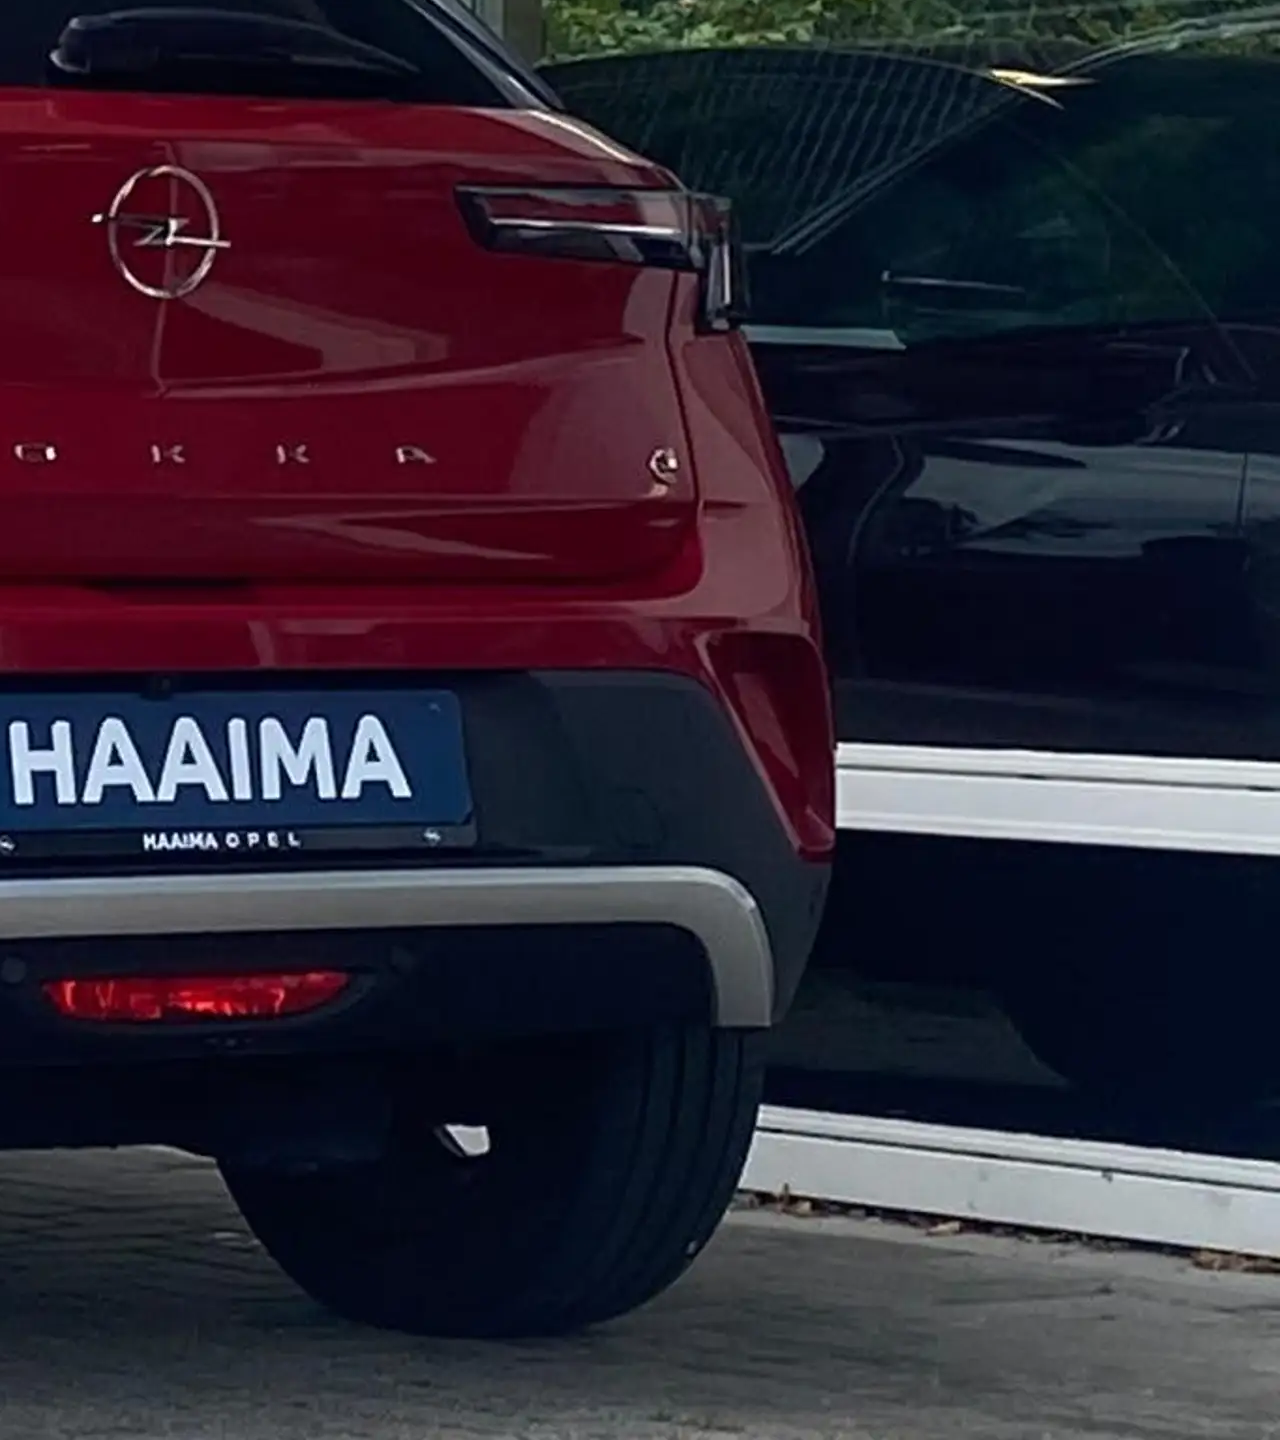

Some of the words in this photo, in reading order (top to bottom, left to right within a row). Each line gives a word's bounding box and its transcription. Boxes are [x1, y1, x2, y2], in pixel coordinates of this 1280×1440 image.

[8, 714, 412, 805] HAAIMA
[143, 831, 219, 851] HAAIMA
[225, 831, 301, 849] OPEL
